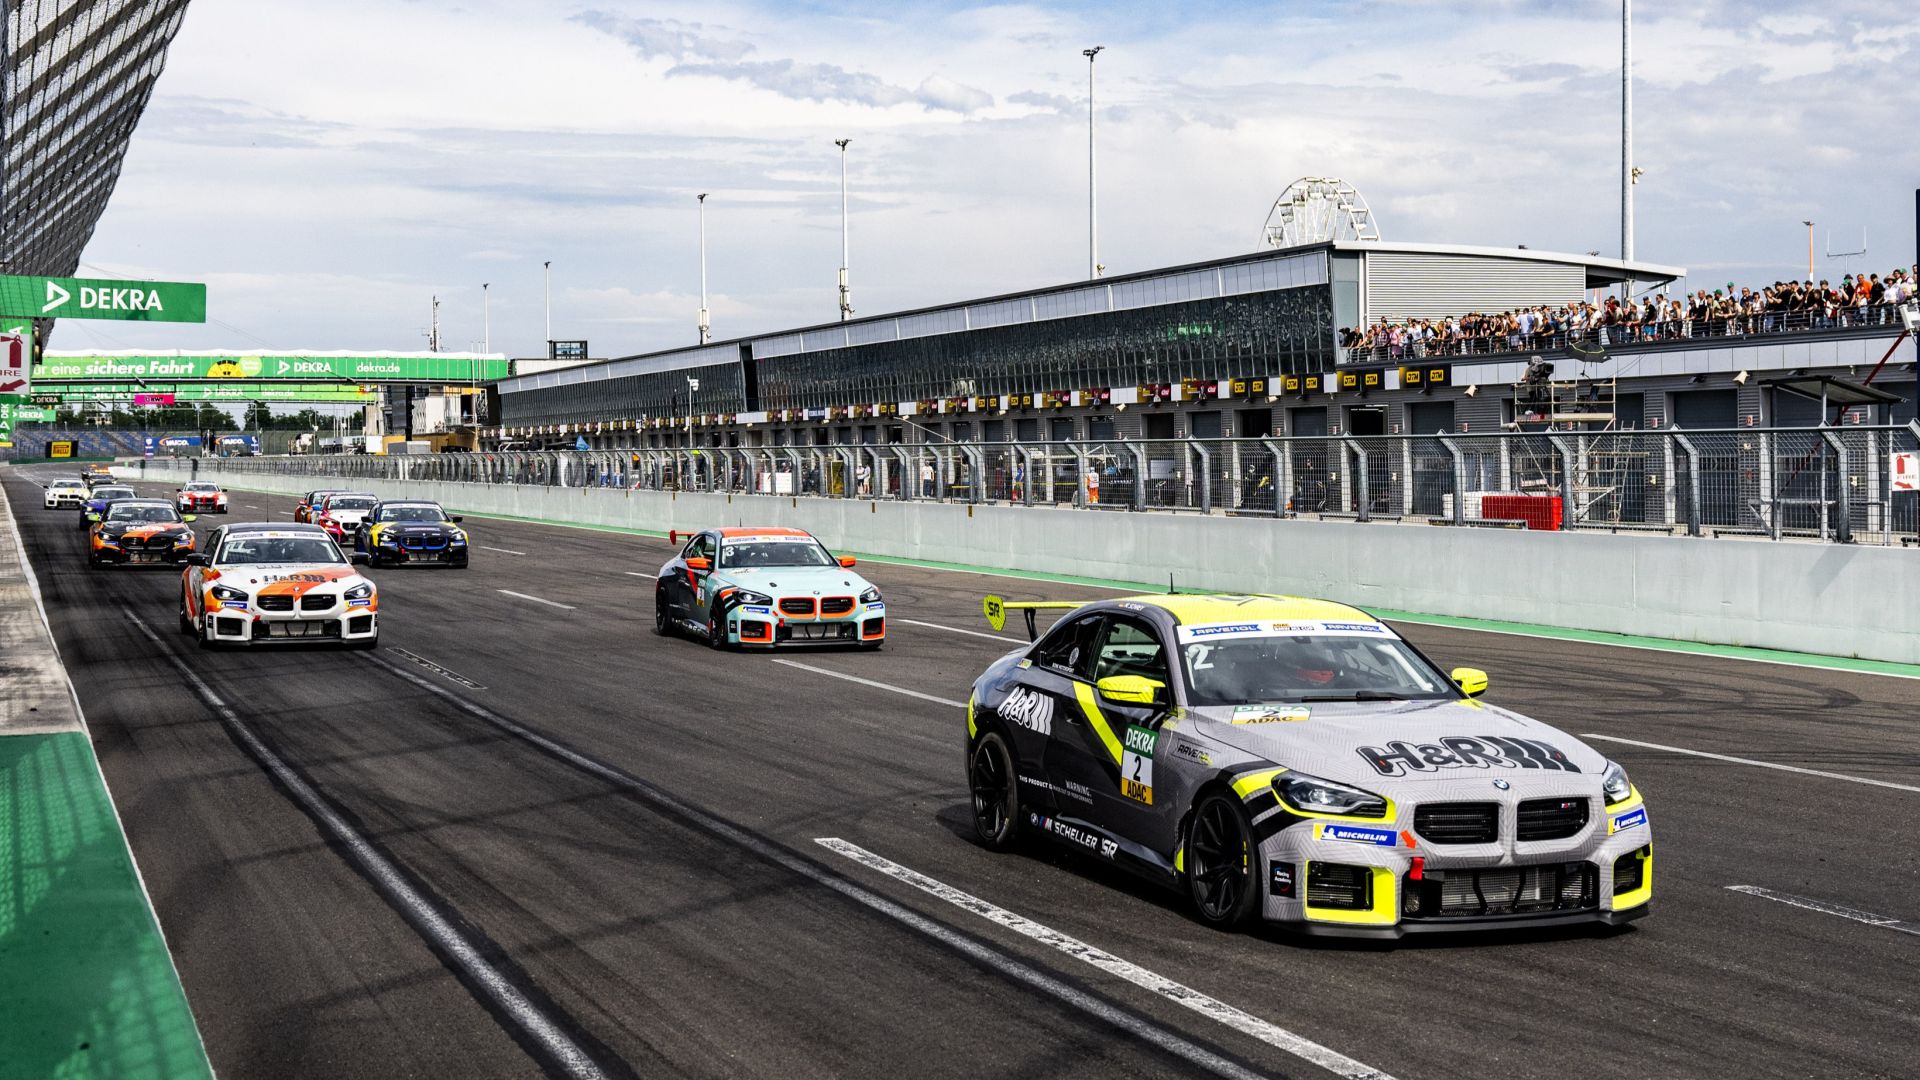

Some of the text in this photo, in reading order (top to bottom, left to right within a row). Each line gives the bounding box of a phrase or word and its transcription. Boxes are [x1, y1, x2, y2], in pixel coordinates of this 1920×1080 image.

[80, 287, 163, 311] DEKRA
[34, 360, 195, 375] ür eine sichere Fahrt
[293, 362, 332, 373] DEKRA
[356, 362, 401, 373] dekra.de
[19, 411, 44, 419] DEKRA
[1196, 625, 1256, 636] RAVENOL
[1326, 624, 1378, 632] RAVENOL
[1188, 644, 1214, 670] 2
[997, 686, 1038, 728] H&R
[1246, 716, 1294, 724] ADAC
[1125, 727, 1156, 752] DEKRA
[1355, 735, 1520, 777] H&R
[1133, 755, 1141, 782] 2
[1019, 774, 1028, 783] THIS
[1028, 777, 1048, 789] PRODUCT
[1127, 783, 1147, 803] ADAC
[1054, 821, 1098, 849] SCHELLER
[1337, 831, 1388, 842] MICHELIN
